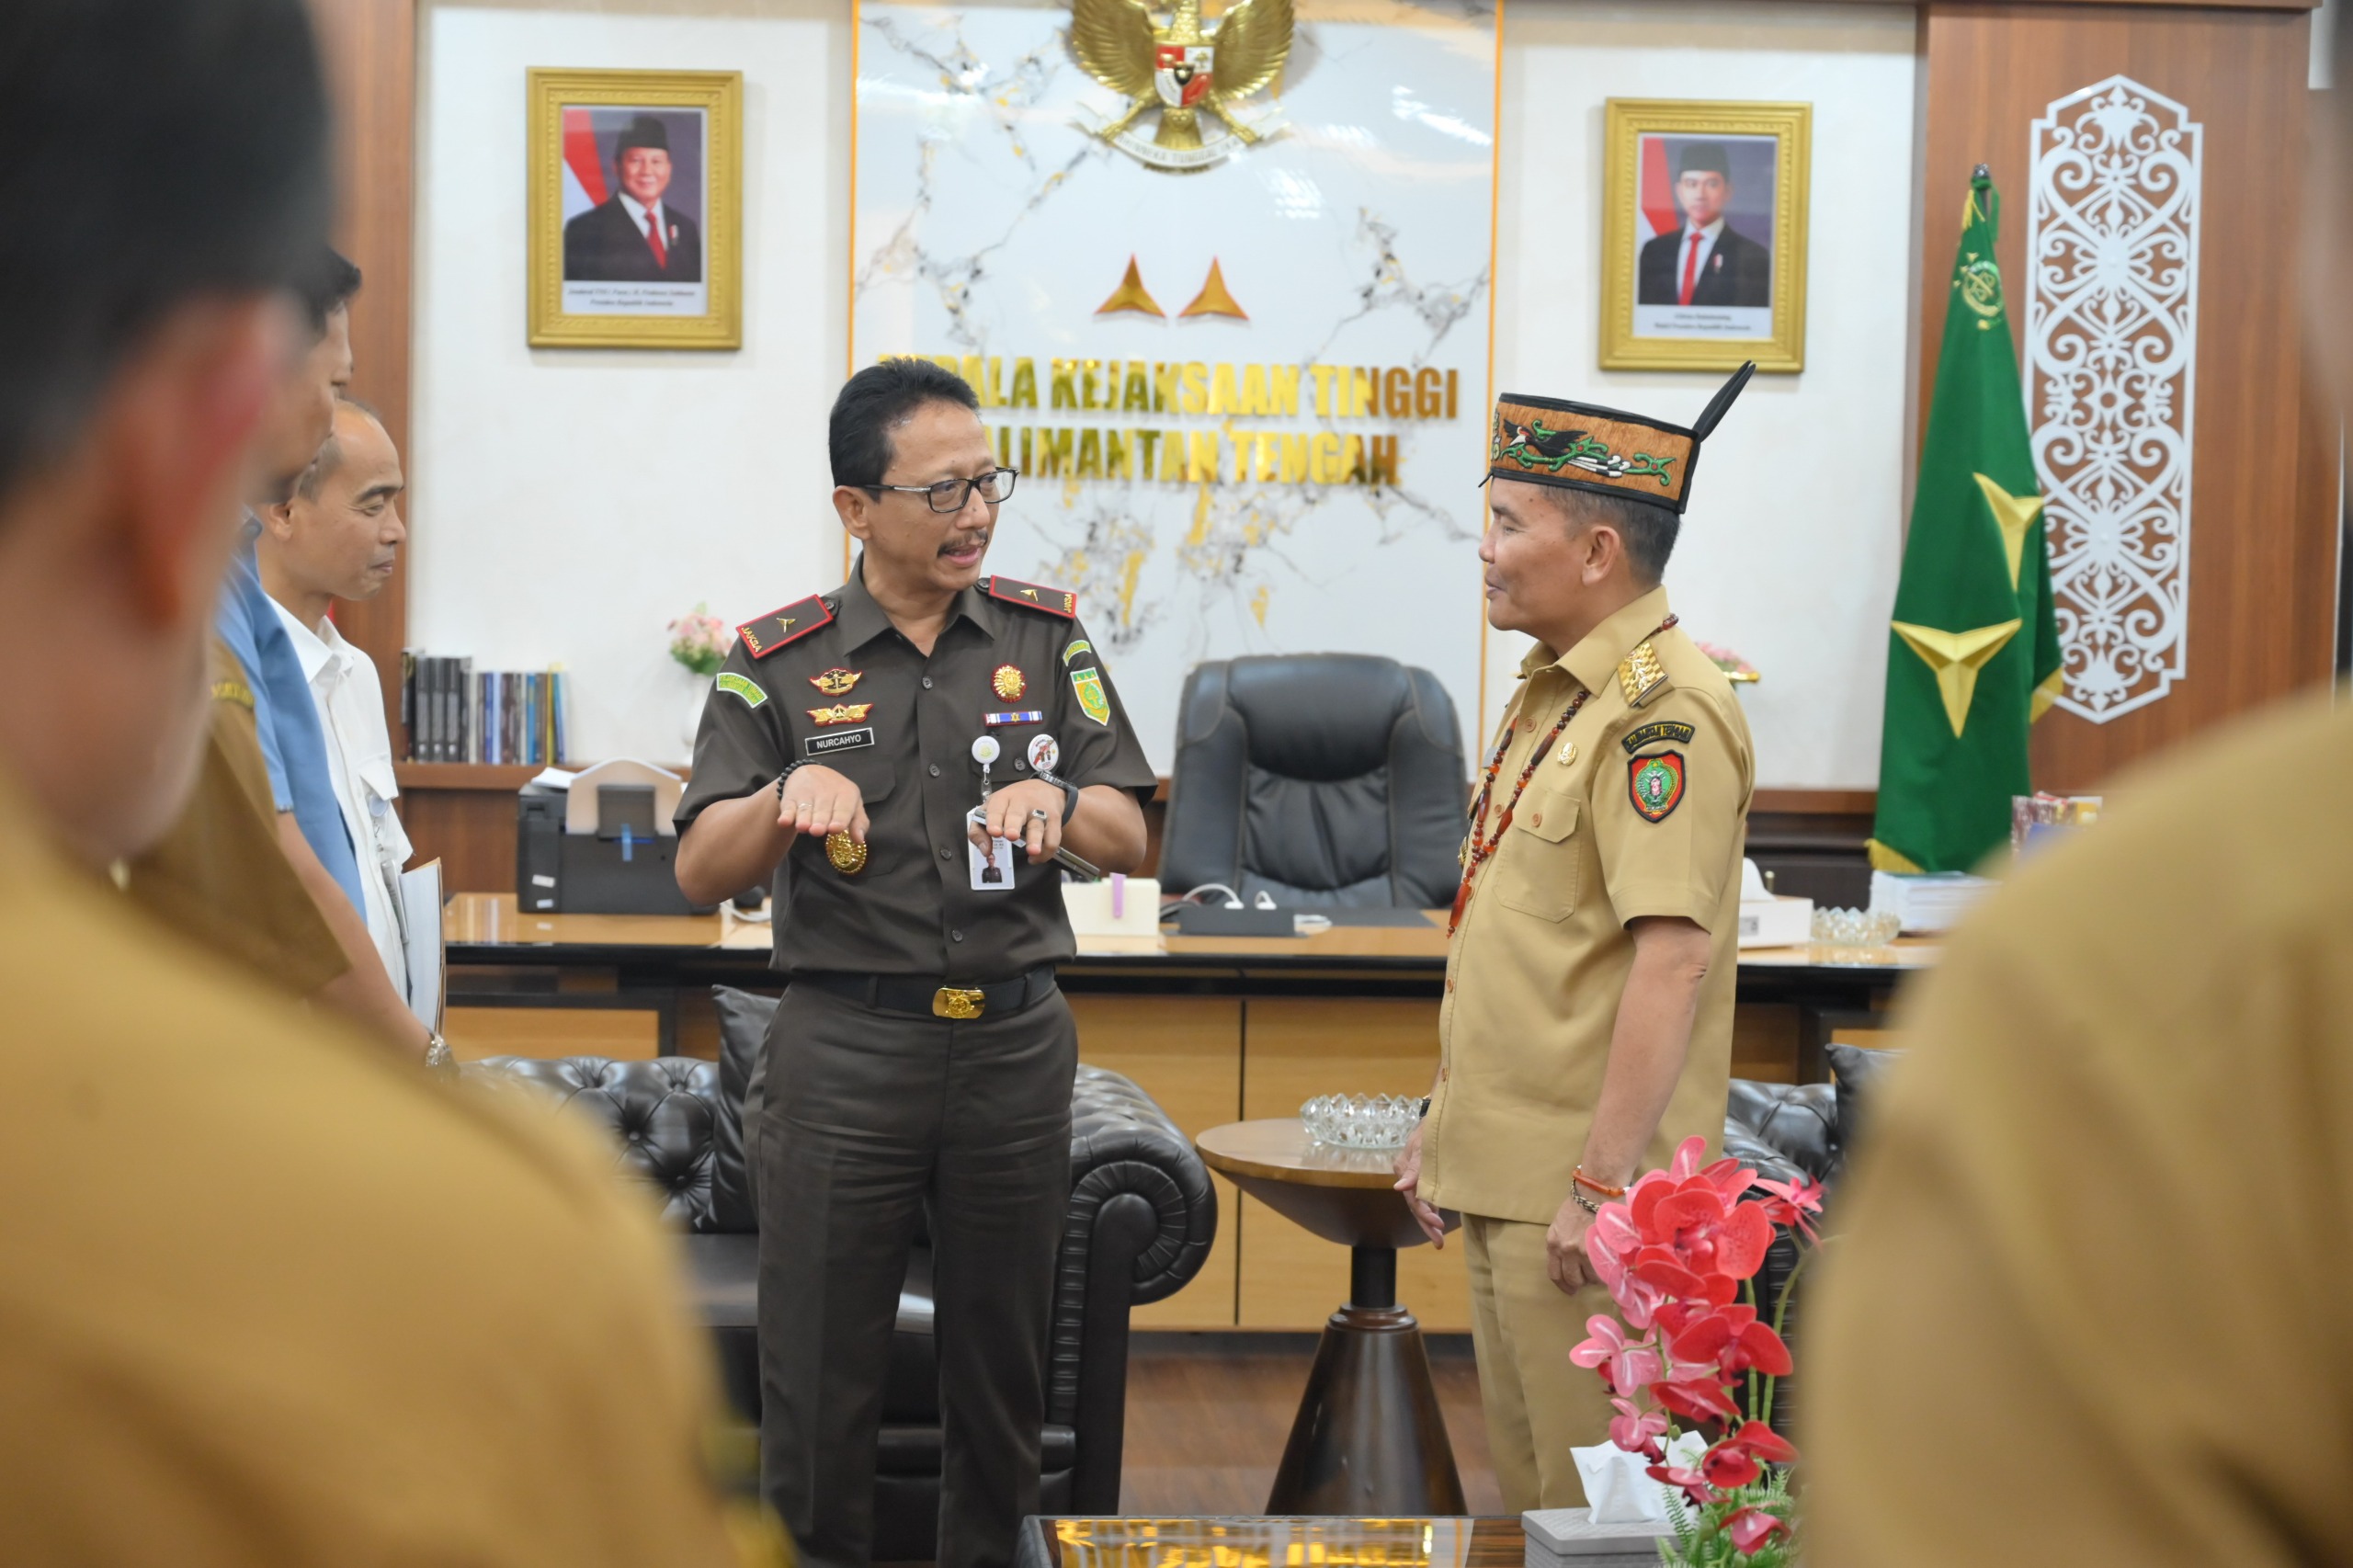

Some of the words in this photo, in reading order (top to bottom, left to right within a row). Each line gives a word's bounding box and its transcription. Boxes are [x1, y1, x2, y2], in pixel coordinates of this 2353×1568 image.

[877, 354, 1038, 408] ALA
[1051, 357, 1300, 416] KEJAKSAAN
[1310, 364, 1458, 420] TINGGI
[983, 426, 1219, 483] LIMANTAN
[1229, 431, 1398, 485] TENGAH
[741, 627, 763, 653] JAKSA
[816, 734, 862, 749] NURCAHYO
